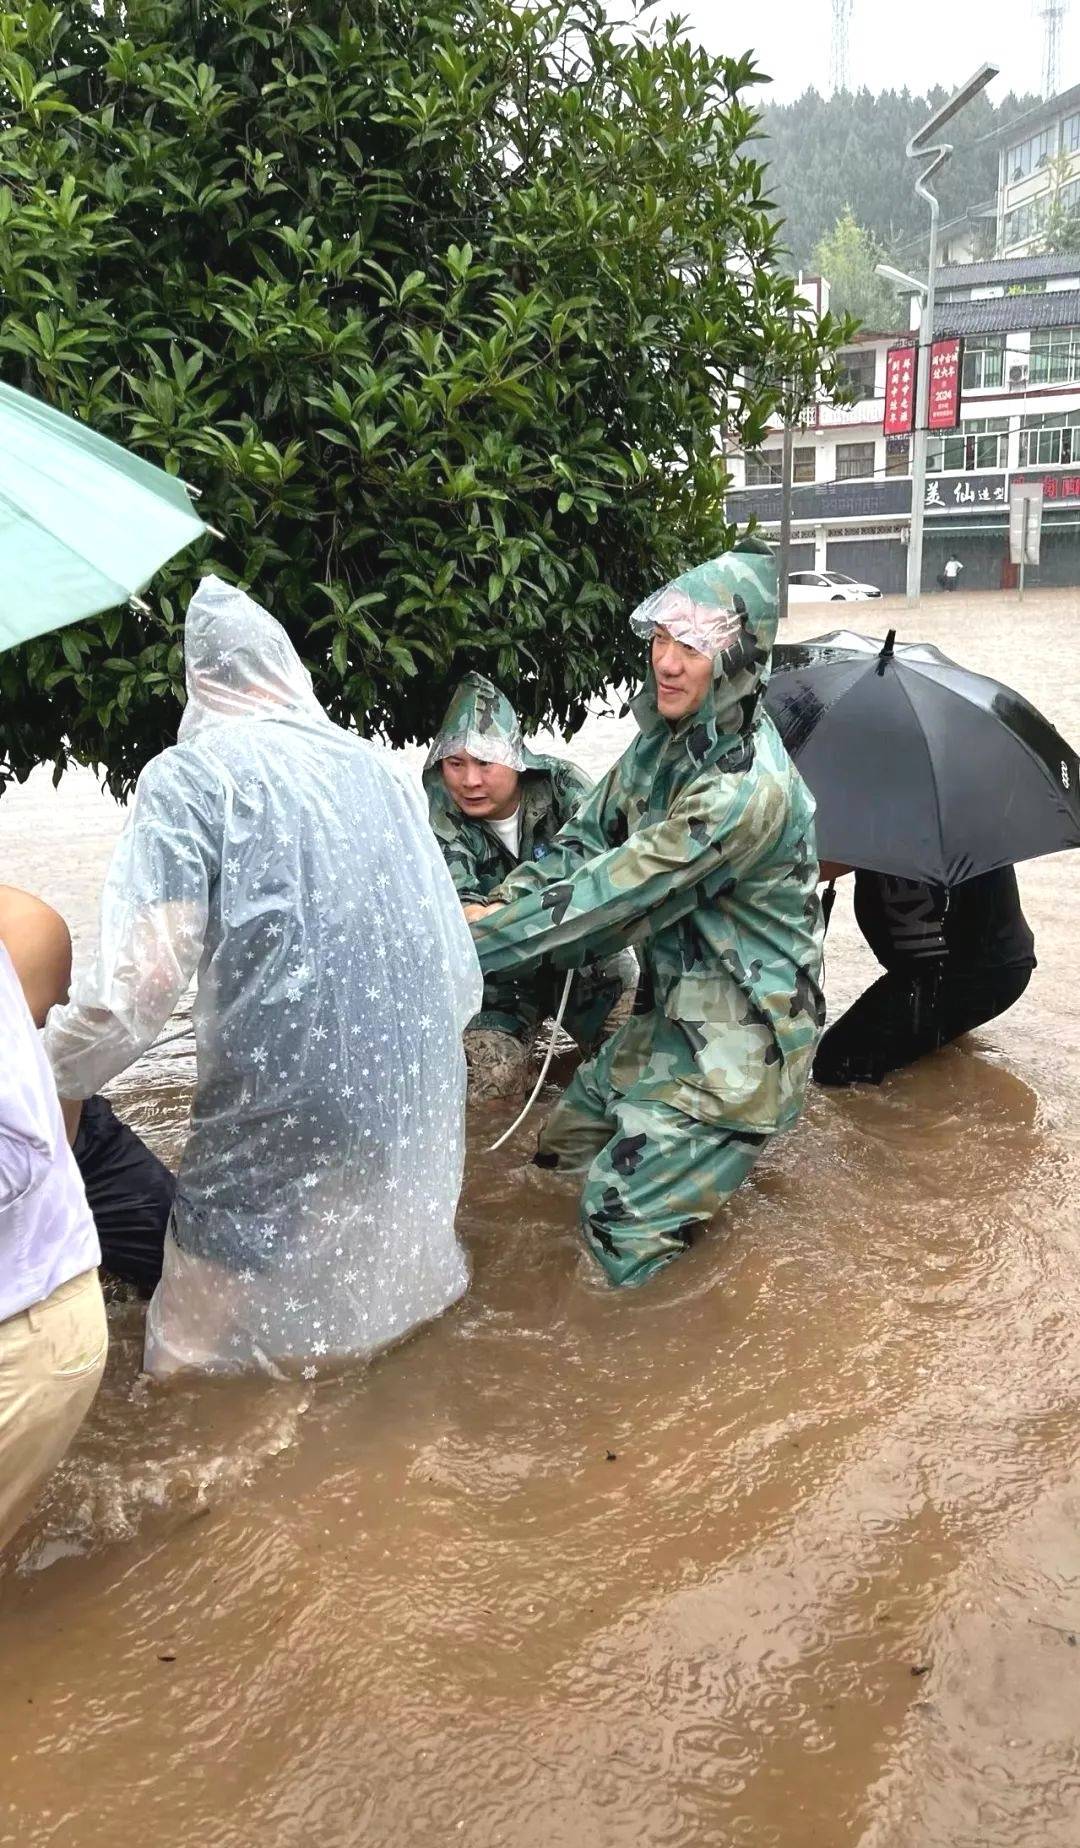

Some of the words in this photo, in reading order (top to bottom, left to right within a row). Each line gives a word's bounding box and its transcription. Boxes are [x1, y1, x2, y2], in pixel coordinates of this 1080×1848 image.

[925, 481, 1005, 507] 美仙造型
[878, 874, 950, 957] IKE
